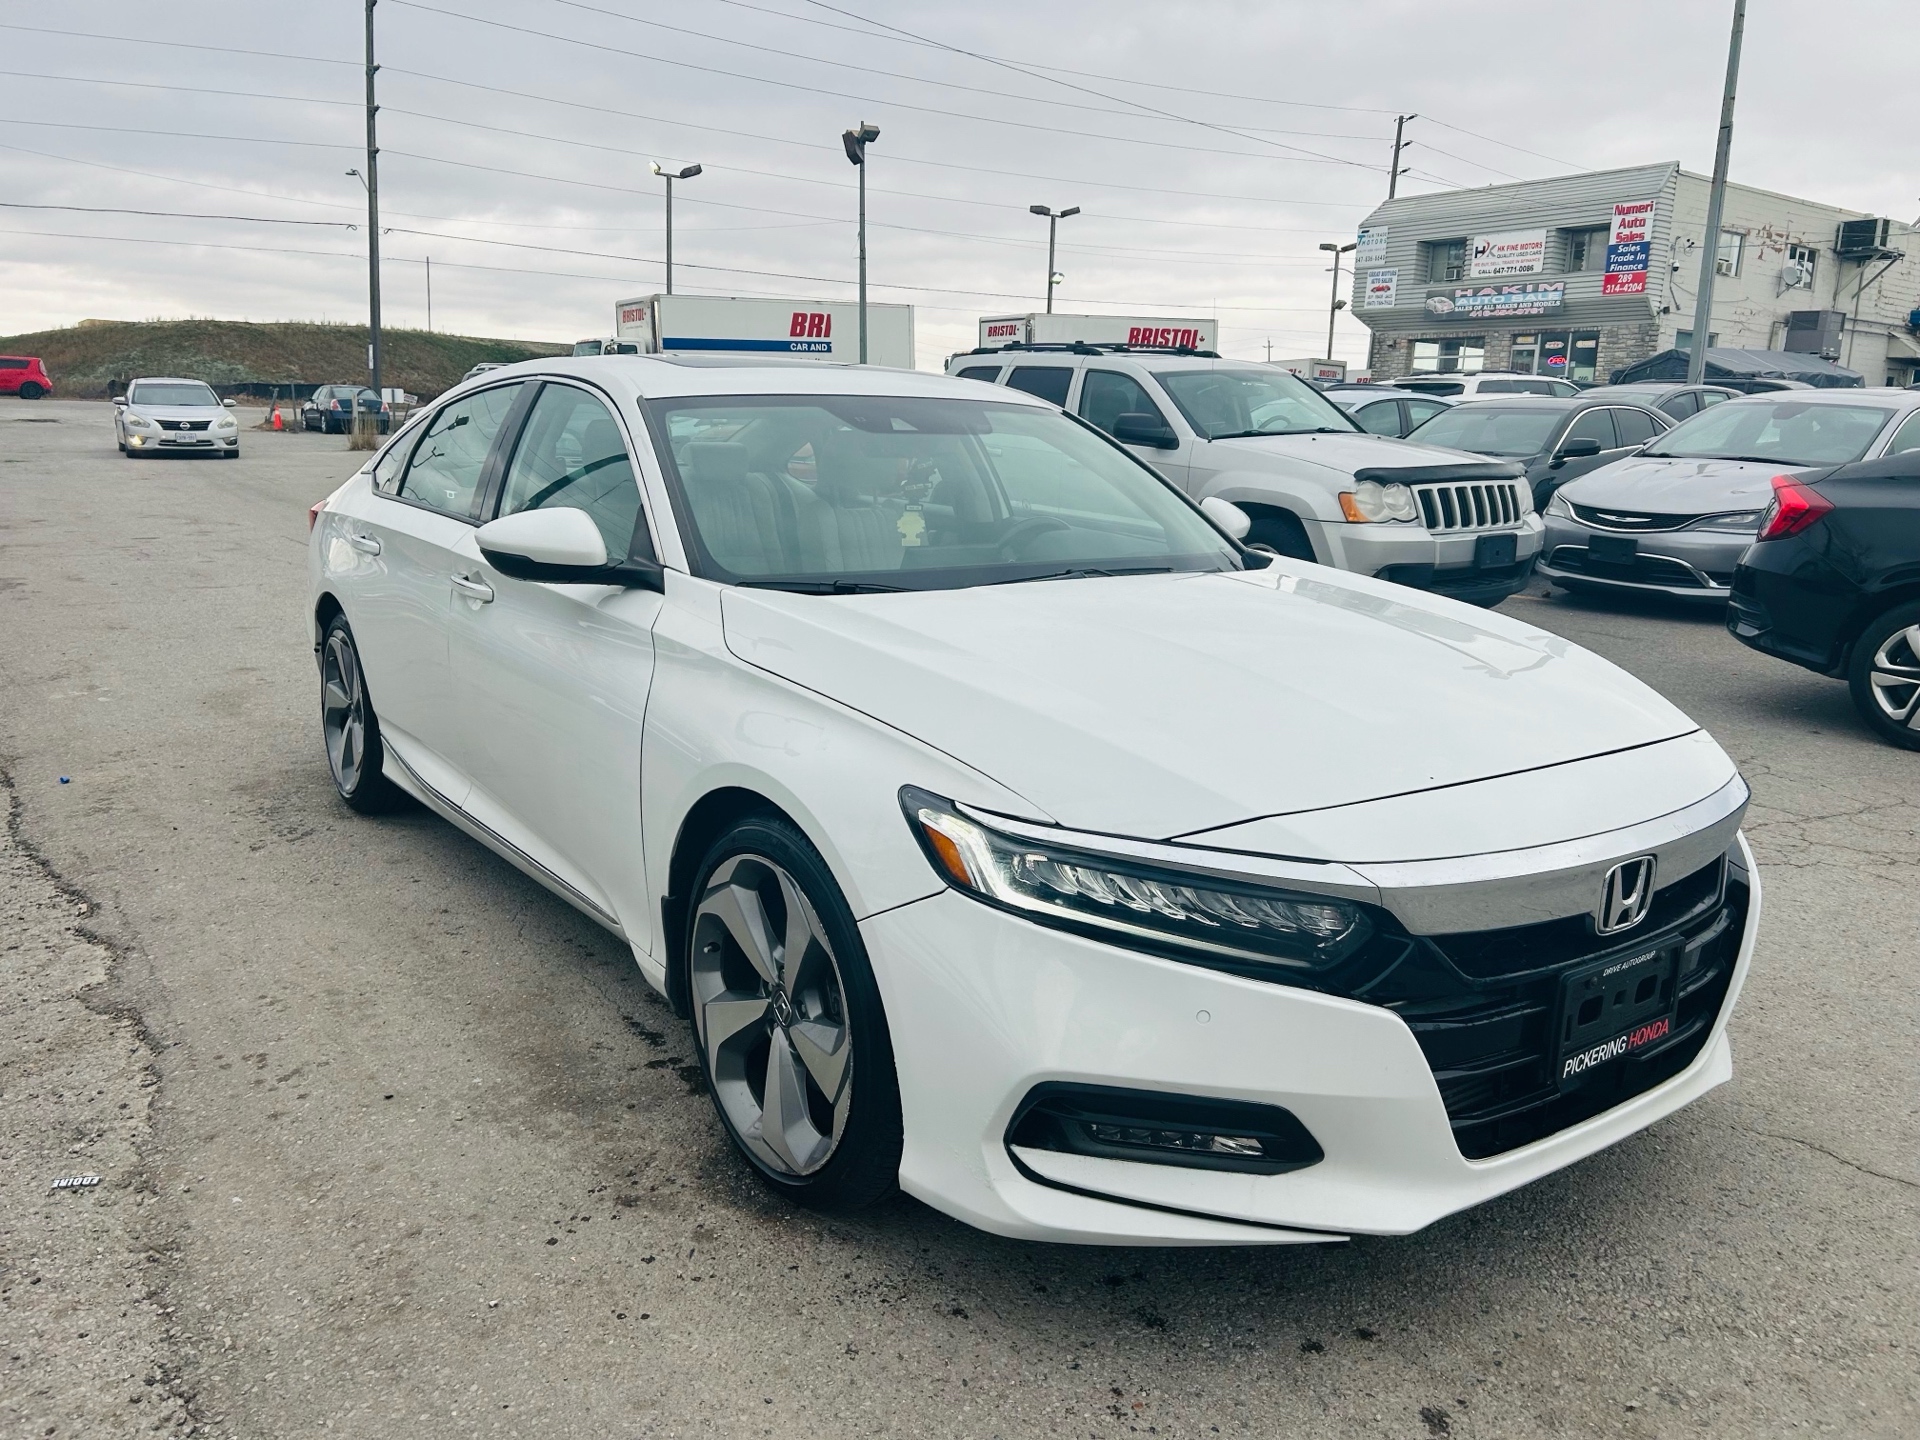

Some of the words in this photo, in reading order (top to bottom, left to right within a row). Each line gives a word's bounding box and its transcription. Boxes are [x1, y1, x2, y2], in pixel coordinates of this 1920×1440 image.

[1614, 200, 1654, 216] Numeri
[1618, 217, 1646, 230] Auto
[1615, 231, 1645, 244] Sales
[1520, 242, 1543, 250] MOTORS
[1617, 244, 1641, 253] Sales
[1610, 254, 1634, 262] Trade
[1636, 252, 1646, 260] In
[1609, 263, 1644, 272] Finance
[1618, 273, 1633, 283] 289
[1455, 282, 1565, 297] HAKIM
[1605, 282, 1643, 293] 314-4204
[1455, 295, 1505, 306] AUTO
[1511, 291, 1560, 303] SALE
[622, 308, 645, 324] BRISTOL
[790, 312, 831, 338] BRI
[987, 324, 1017, 337] BRISTOL
[1127, 327, 1199, 350] BRISTOL
[790, 342, 808, 351] CAR
[810, 343, 828, 351] AND
[1548, 356, 1568, 365] OPEN
[1603, 963, 1622, 977] DRIVE
[1621, 950, 1656, 971] AUTOGROUP
[1562, 1035, 1628, 1078] PICKERING
[1628, 1018, 1669, 1049] HONDA
